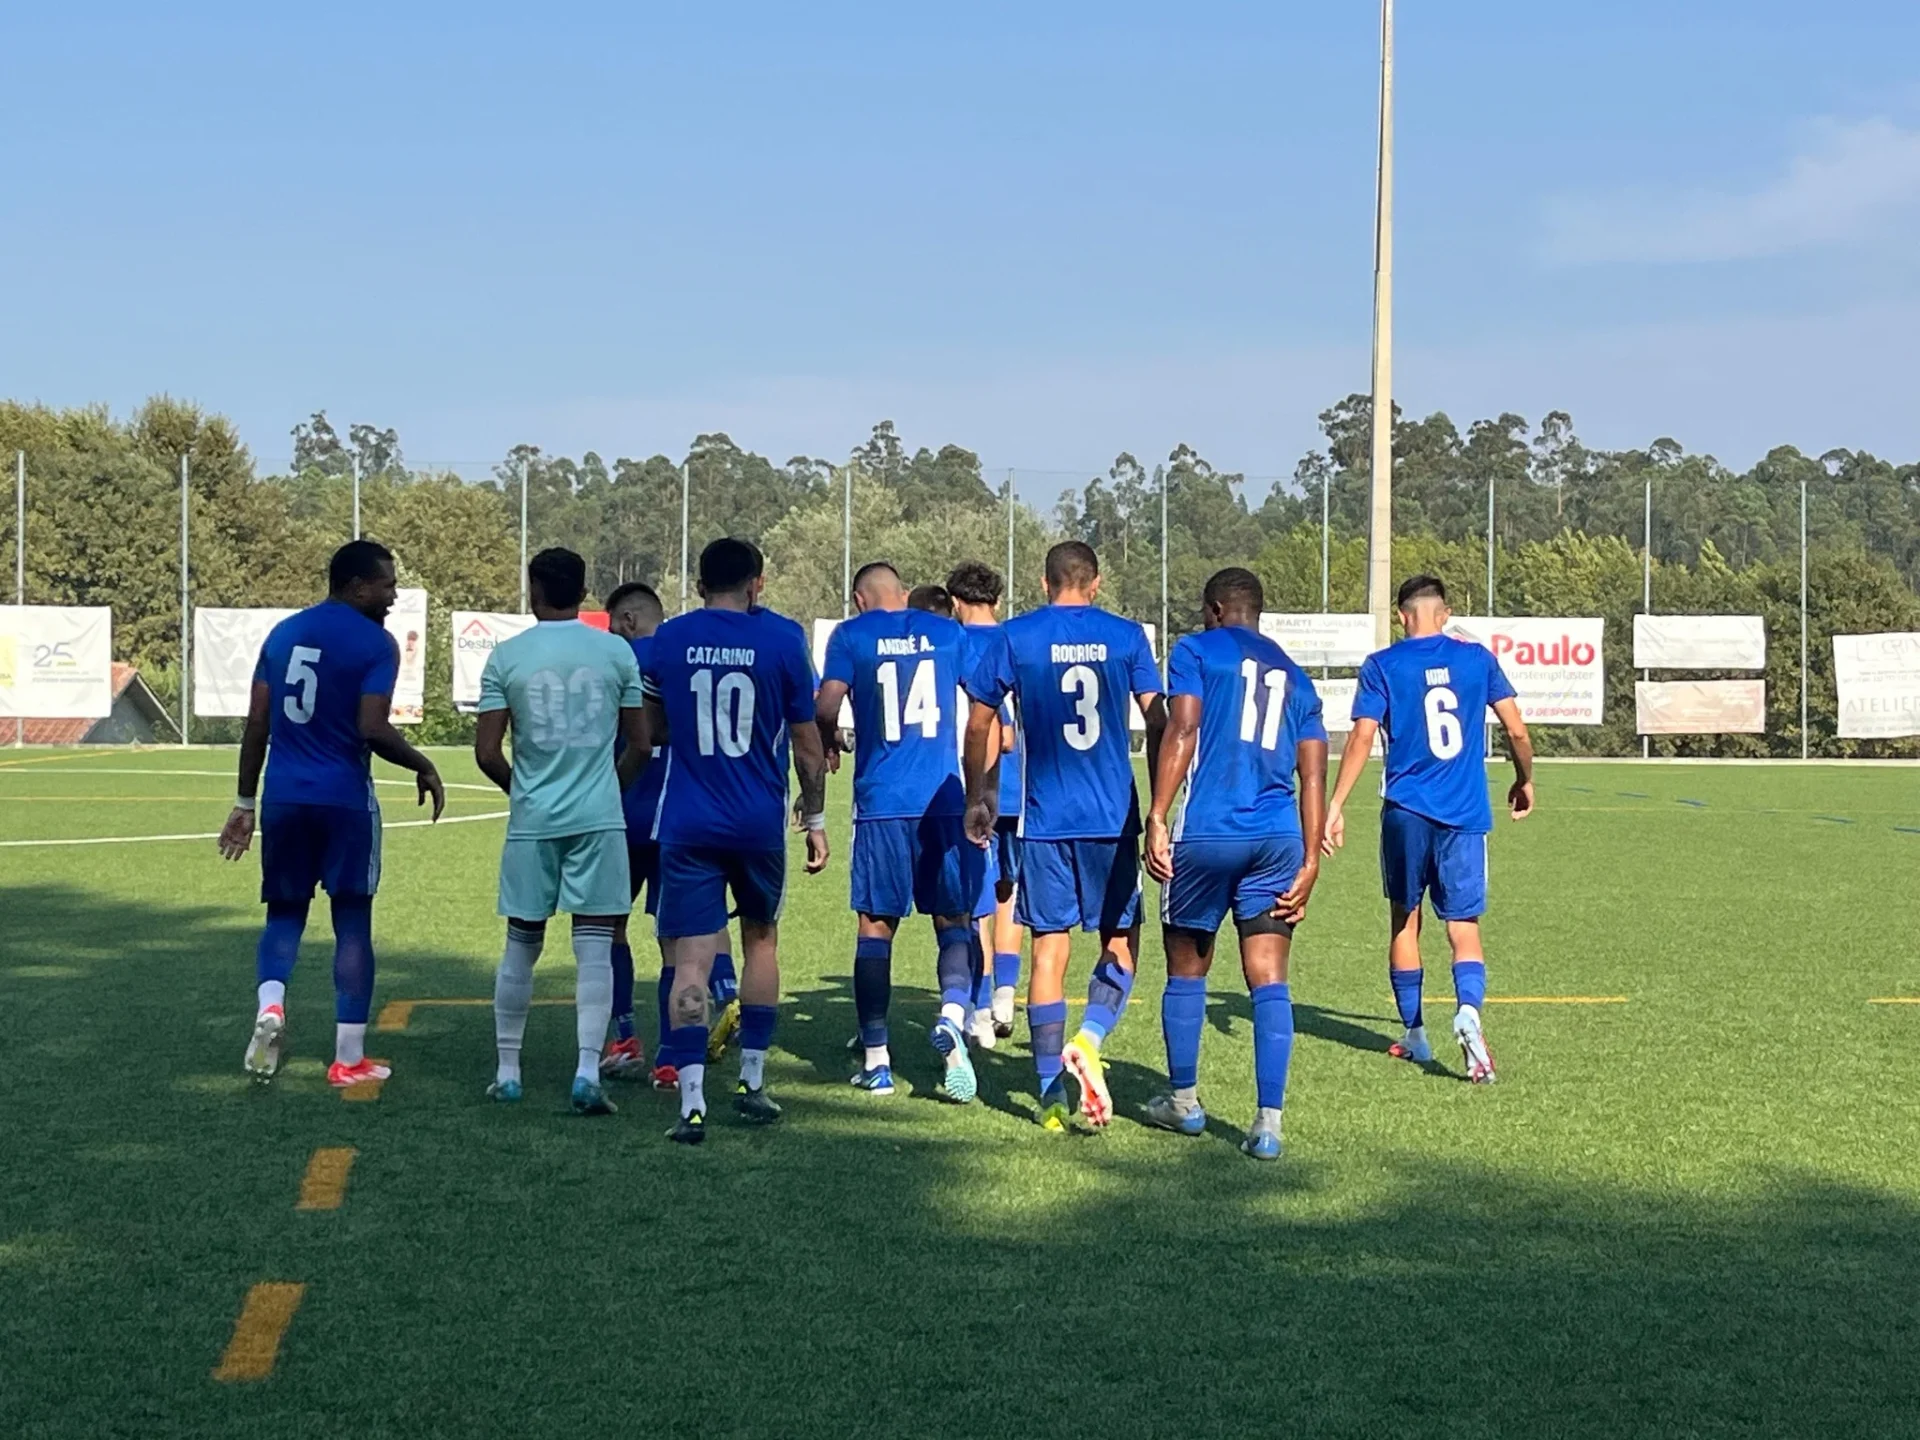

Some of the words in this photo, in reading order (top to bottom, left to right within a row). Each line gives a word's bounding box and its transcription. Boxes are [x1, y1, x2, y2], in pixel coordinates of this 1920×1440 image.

[33, 641, 73, 668] 25
[686, 646, 756, 666] CATARINO
[876, 634, 917, 656] ANDRÉ
[1051, 643, 1107, 663] RODRIGO
[1490, 634, 1595, 666] Paulo
[283, 645, 322, 724] 5
[876, 659, 941, 742] 14
[1060, 664, 1101, 751] 3
[1240, 658, 1287, 751] 11
[690, 669, 756, 758] 10
[1424, 686, 1463, 760] 6
[1535, 706, 1592, 717] DESPORTO
